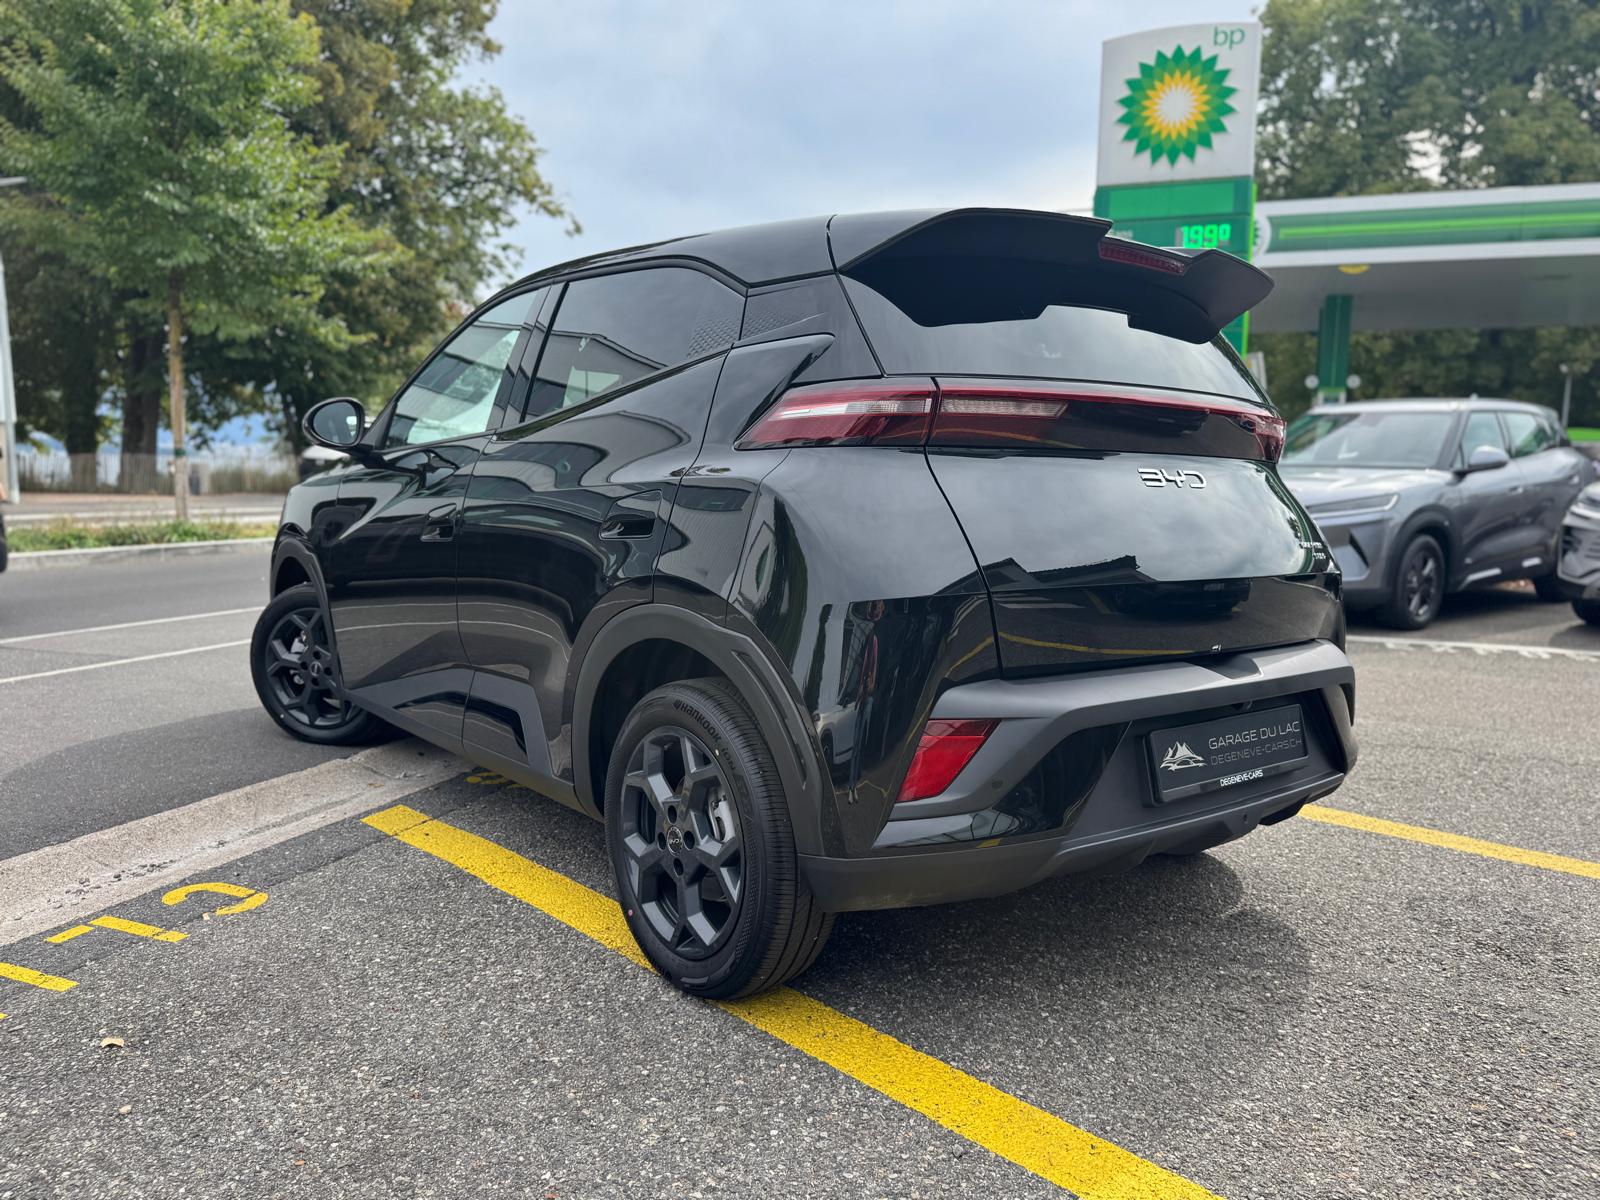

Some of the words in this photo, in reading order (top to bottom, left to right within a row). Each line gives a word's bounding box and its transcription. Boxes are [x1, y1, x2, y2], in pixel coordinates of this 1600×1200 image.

[1213, 26, 1245, 49] bp
[1137, 468, 1207, 489] BYD
[1208, 729, 1258, 750] GARAGE
[1259, 726, 1277, 739] DU
[1278, 721, 1301, 735] LAC
[1220, 769, 1263, 787] DEGENEVE-CARS
